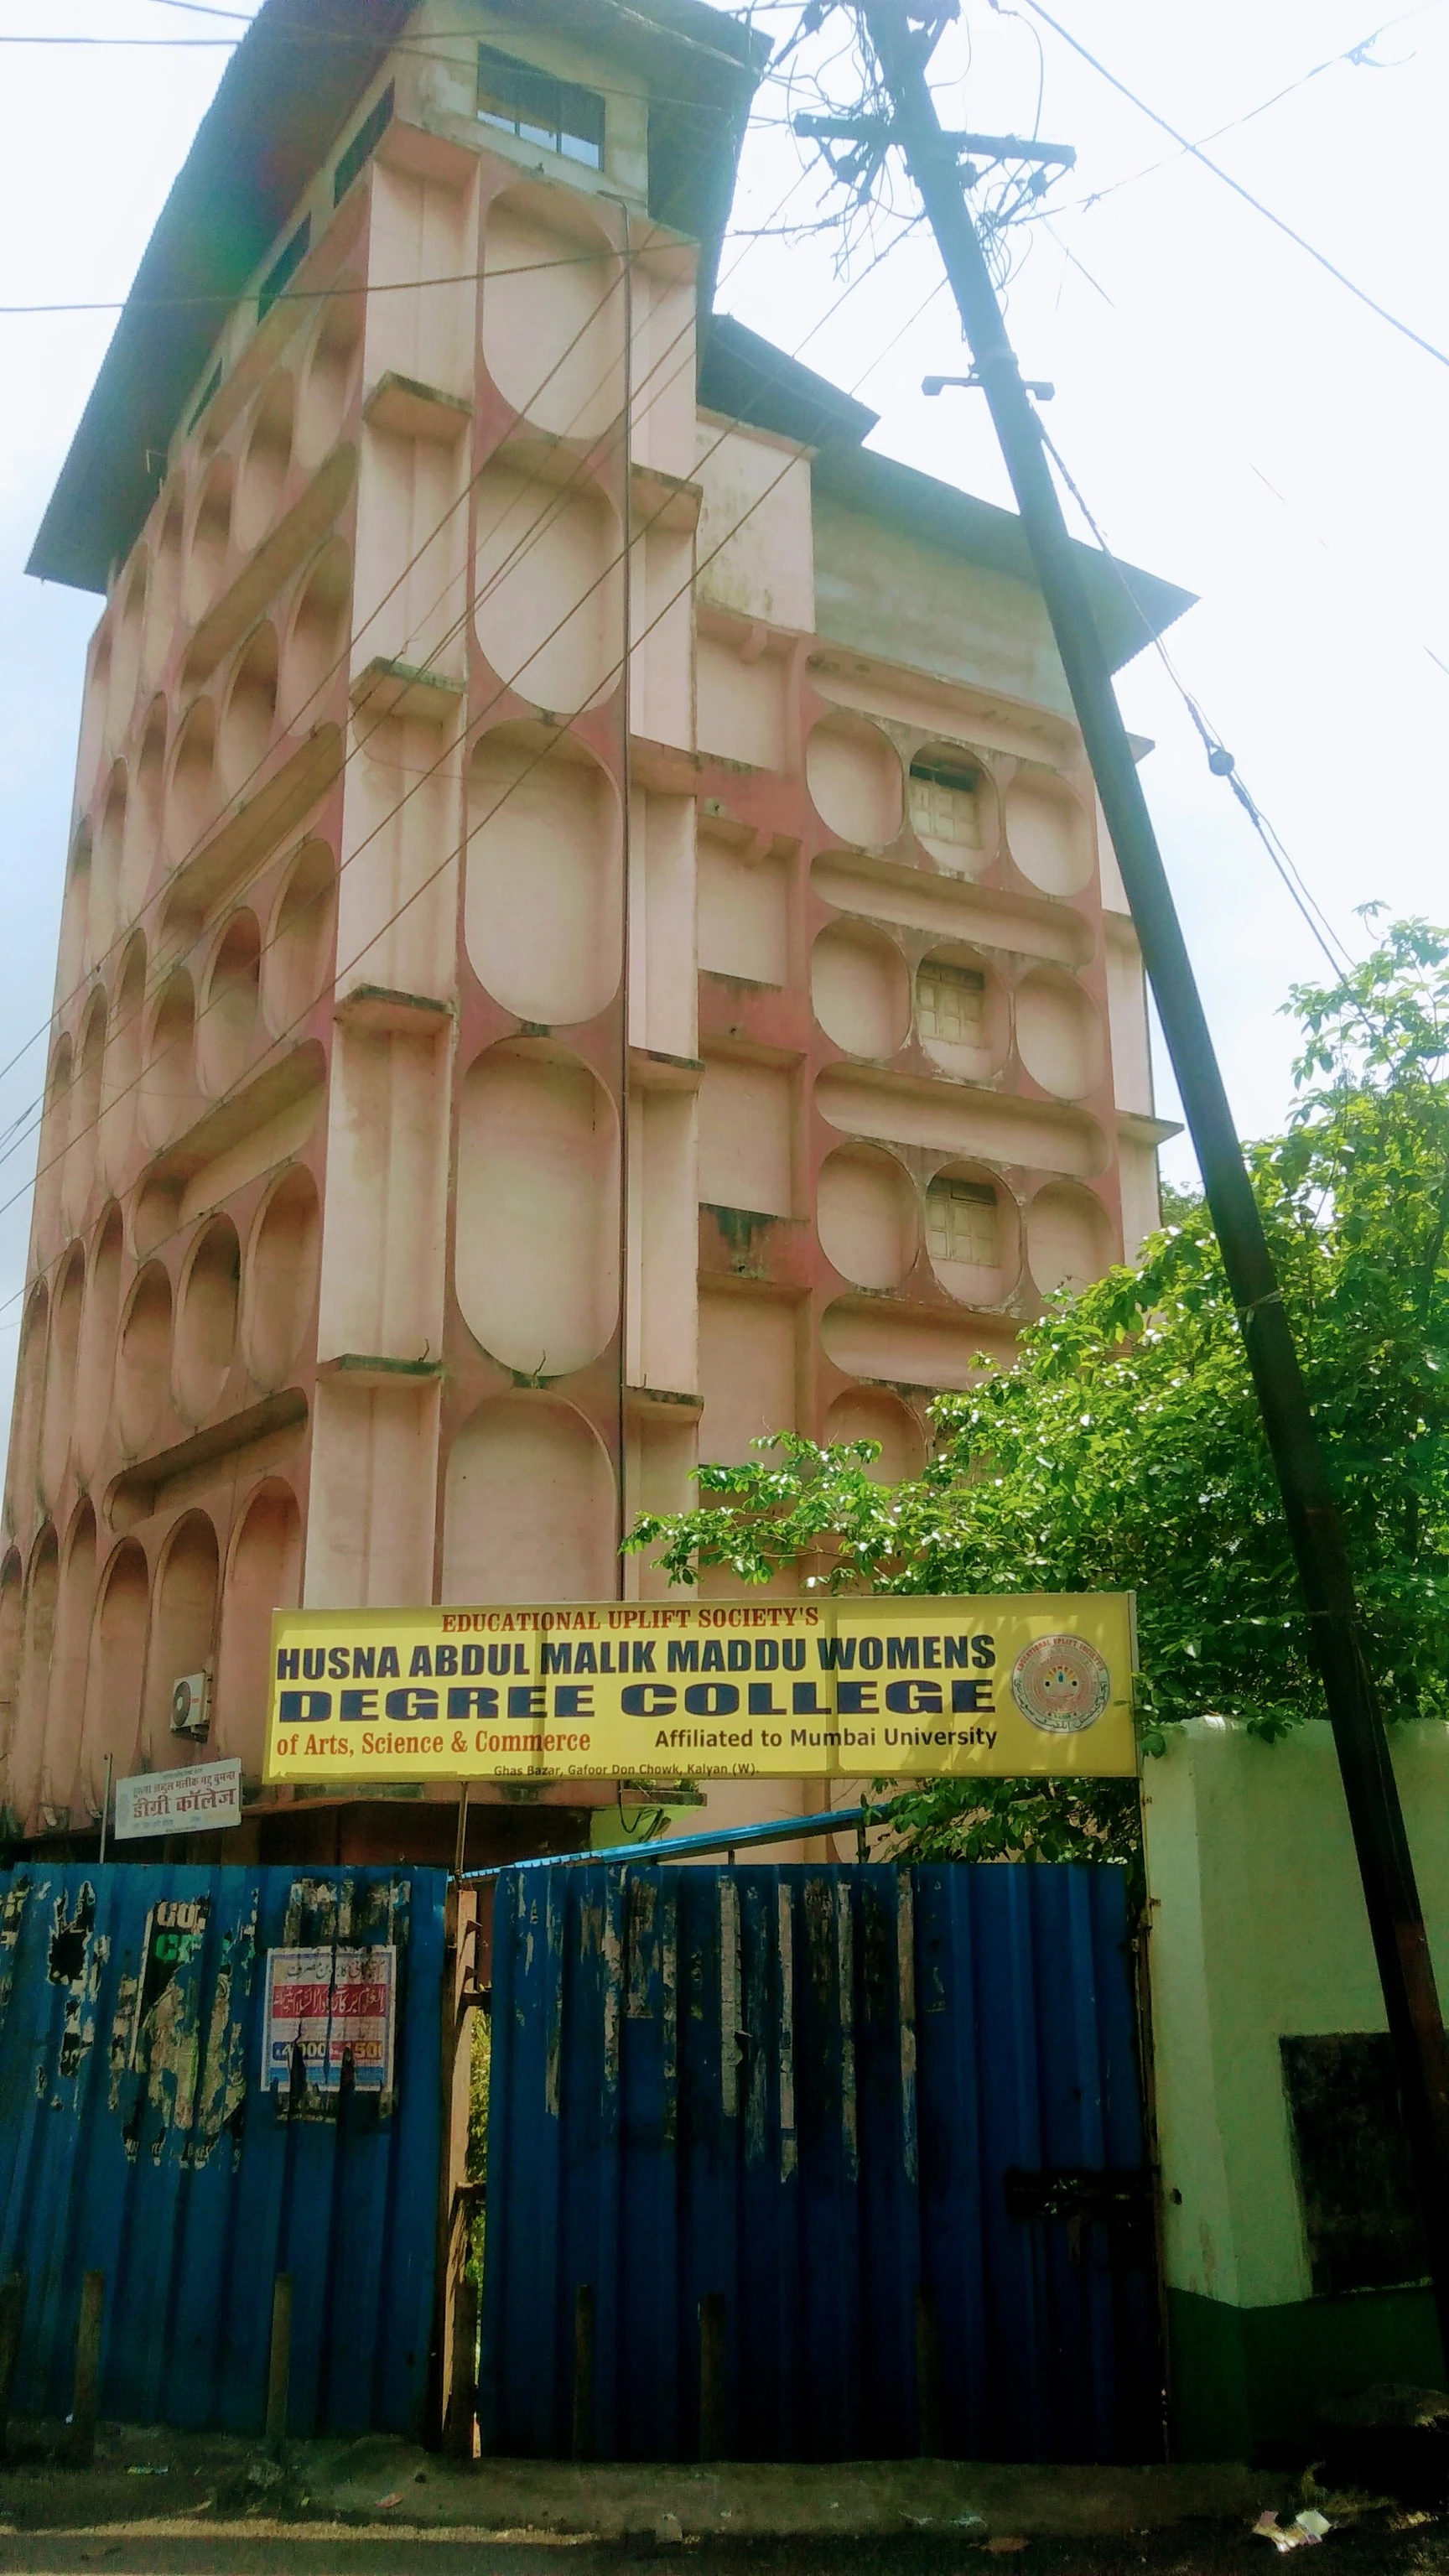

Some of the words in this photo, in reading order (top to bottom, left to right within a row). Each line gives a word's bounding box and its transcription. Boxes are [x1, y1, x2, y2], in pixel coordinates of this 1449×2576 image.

[442, 1611, 600, 1633] EDUCATIONAL
[609, 1609, 691, 1629] UPLIFT
[699, 1607, 819, 1628] SOCIETY'S
[277, 1646, 401, 1680] HUSNA
[408, 1644, 530, 1677] ABDUL
[541, 1640, 657, 1675] MALIK
[668, 1638, 807, 1673] MADDU
[818, 1634, 996, 1670] WOMENS
[279, 1685, 595, 1722] DEGREE
[621, 1680, 996, 1717] COLLEGE
[277, 1733, 299, 1755] of
[304, 1733, 355, 1758] Arts,
[361, 1731, 444, 1754] Science
[450, 1731, 469, 1753] &
[475, 1729, 591, 1752] Commerce
[655, 1728, 753, 1748] Affiliated
[761, 1731, 783, 1748] to
[791, 1727, 876, 1747] Mumbai
[884, 1727, 999, 1750] University
[494, 1765, 524, 1777] Ghas
[527, 1765, 564, 1778] Bazar,
[568, 1763, 609, 1776] Gafoor
[611, 1764, 636, 1775] Don
[639, 1763, 683, 1777] Chowk,
[687, 1763, 729, 1777] Kalyan
[176, 1787, 236, 1812] कॉलेज
